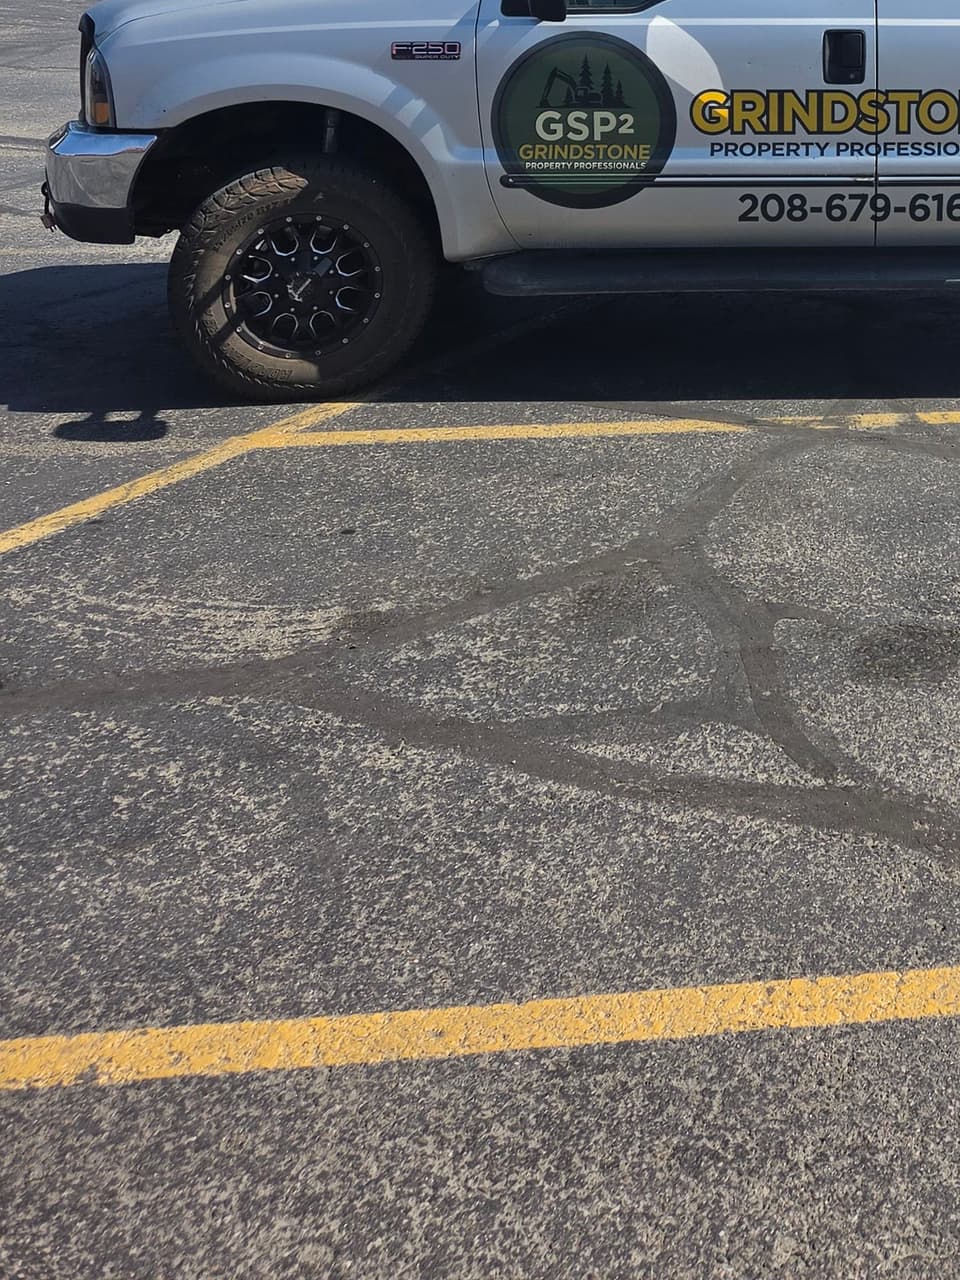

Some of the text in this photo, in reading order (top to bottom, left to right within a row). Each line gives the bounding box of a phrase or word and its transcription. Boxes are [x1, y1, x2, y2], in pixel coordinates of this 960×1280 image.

[519, 144, 650, 160] GRINDSTONE
[709, 142, 829, 157] PROPERTY
[525, 162, 647, 170] PROPERTY PROFESSIONALS
